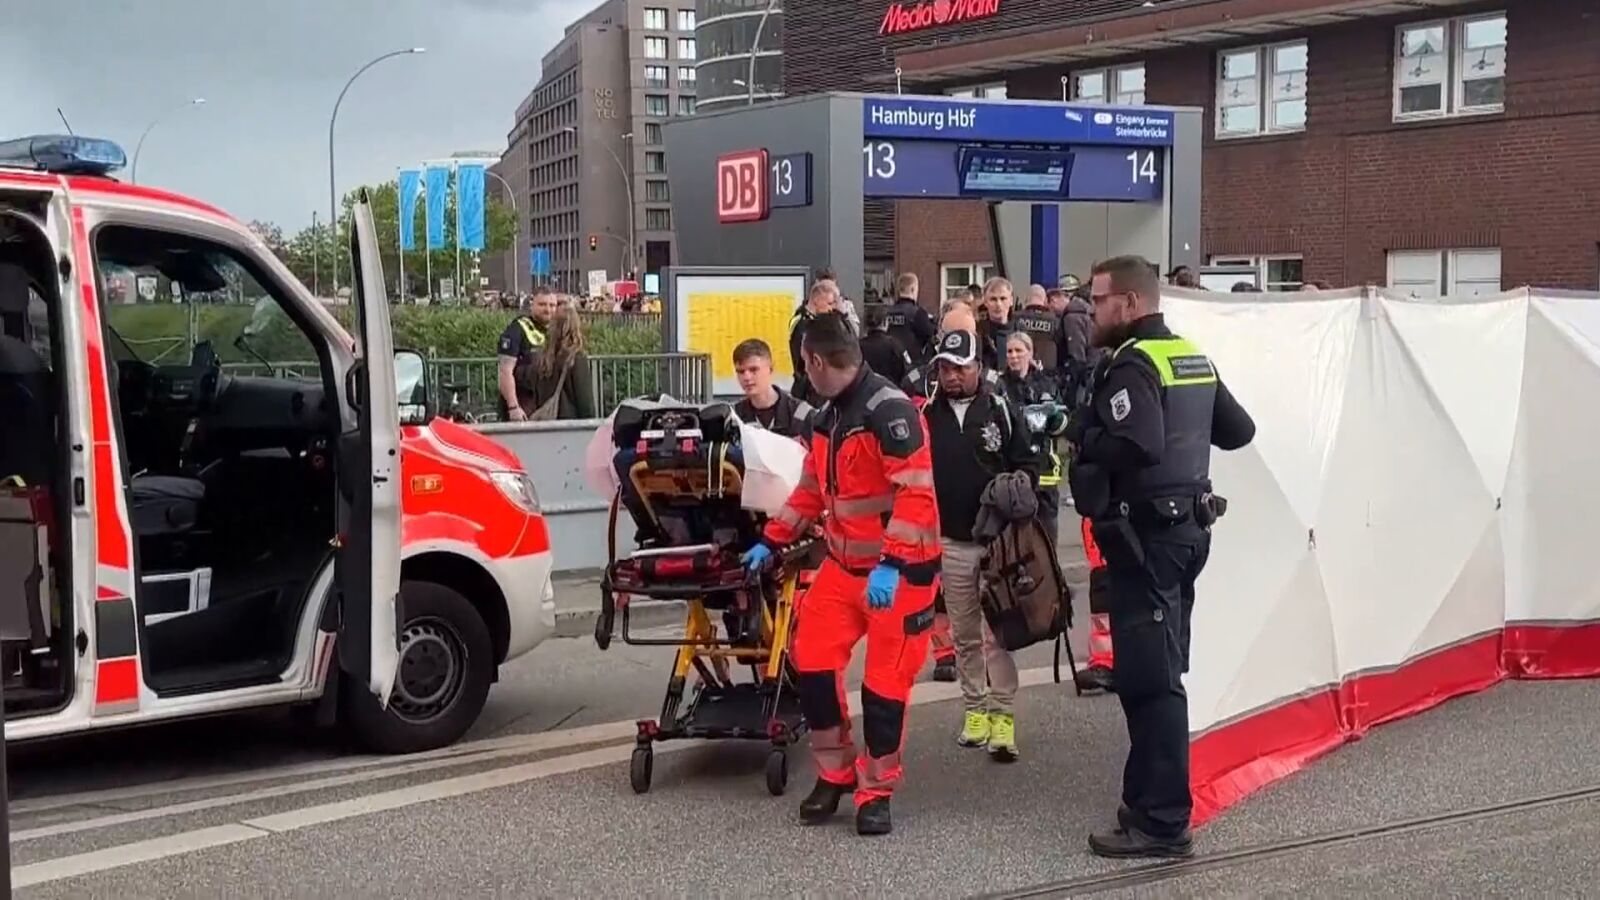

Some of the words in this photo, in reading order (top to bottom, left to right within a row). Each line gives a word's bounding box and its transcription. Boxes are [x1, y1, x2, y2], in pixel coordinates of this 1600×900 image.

[879, 3, 933, 34] Media
[871, 105, 944, 131] Hamburg
[948, 107, 977, 128] Hbf
[1115, 113, 1145, 127] Eingang
[863, 142, 896, 179] 13
[1126, 150, 1158, 184] 14
[721, 163, 757, 211] DB
[772, 159, 793, 195] 13
[1019, 318, 1051, 332] POLIZEI
